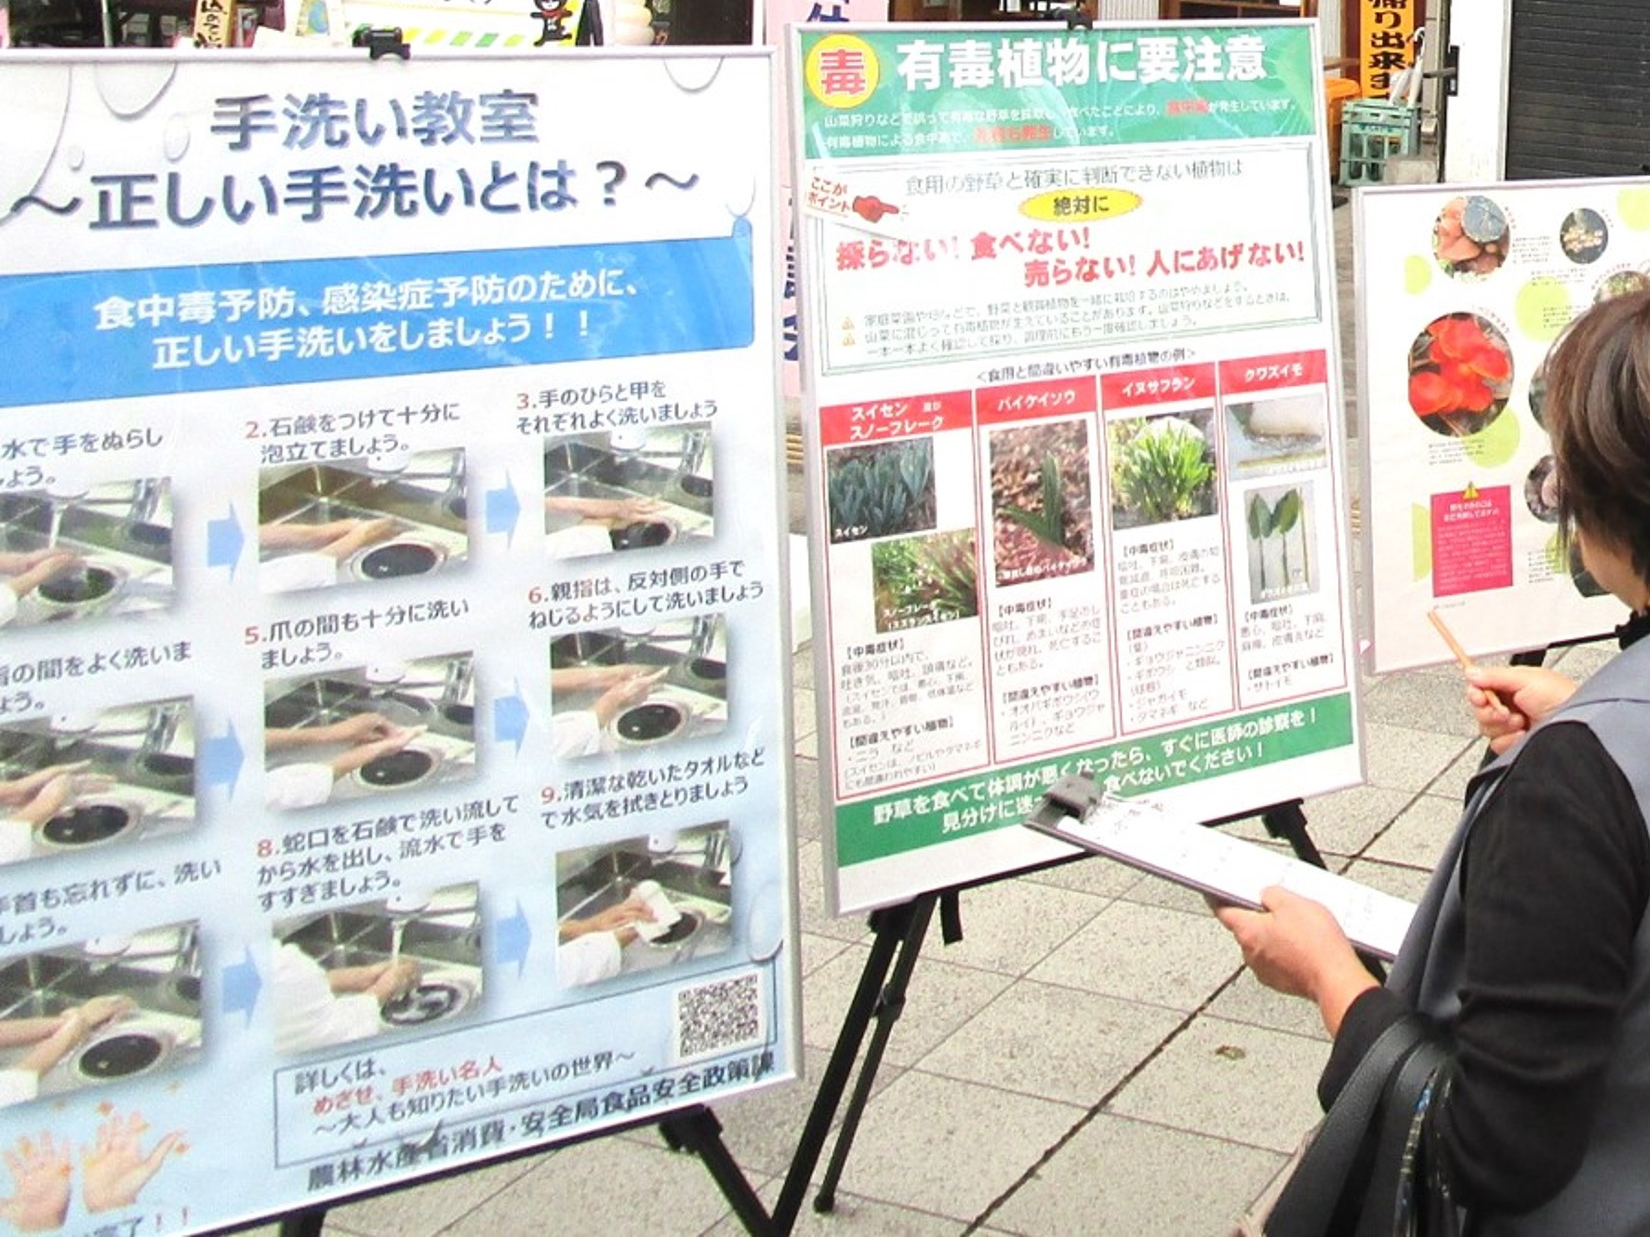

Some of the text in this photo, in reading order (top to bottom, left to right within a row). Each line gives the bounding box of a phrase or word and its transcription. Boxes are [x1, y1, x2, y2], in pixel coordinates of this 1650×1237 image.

[821, 49, 866, 95] 毒
[896, 34, 1268, 92] 有毒植物に要注意
[210, 88, 541, 150] 手洗い教室
[9, 159, 699, 231] ～正しい手洗いとは？～
[811, 175, 849, 197] ここが
[906, 159, 1243, 196] 食用の野草と確実に判断できない植物は
[807, 191, 851, 213] ポイント
[1053, 194, 1111, 217] 絶対に
[836, 226, 1091, 271] 採らない！ 食べない！
[1024, 240, 1305, 288] 売らない！ 人にあげない！
[93, 265, 640, 330] 食中毒予防、感染症予防のために、
[153, 309, 593, 370] 正しい手洗いをしましょう！！
[1122, 376, 1197, 397] イヌサフラン
[1244, 362, 1303, 382] クワズイモ
[516, 399, 719, 435] それぞれよく洗いましょう
[517, 380, 667, 411] 3.手のひらと甲を
[852, 403, 909, 422] スイセン
[997, 390, 1076, 412] バイケイソウ
[245, 402, 461, 439] 2.石鹸をつけて十分に
[850, 415, 945, 441] スノーフレーク
[261, 434, 410, 464] 泡立てましょう。
[0, 465, 56, 488] ょう。
[528, 559, 745, 607] 6.親指は、反対側の手で
[244, 598, 470, 646] 5.爪の間も十分に洗い
[529, 581, 766, 631] ねじるようにして洗いましょう
[261, 643, 345, 669] ましょう。
[541, 746, 766, 805] 9.清潔な乾いたタオルなど
[541, 775, 749, 830] で水気を拭きとりましょう
[257, 794, 520, 858] 8.蛇口を石鹸で洗い流して
[258, 823, 507, 886] から水を出し、流水で手を
[258, 869, 401, 912] すすぎましょう。
[294, 1059, 387, 1094] 詳しくは、
[312, 1055, 503, 1116] めざせ、手洗い名人
